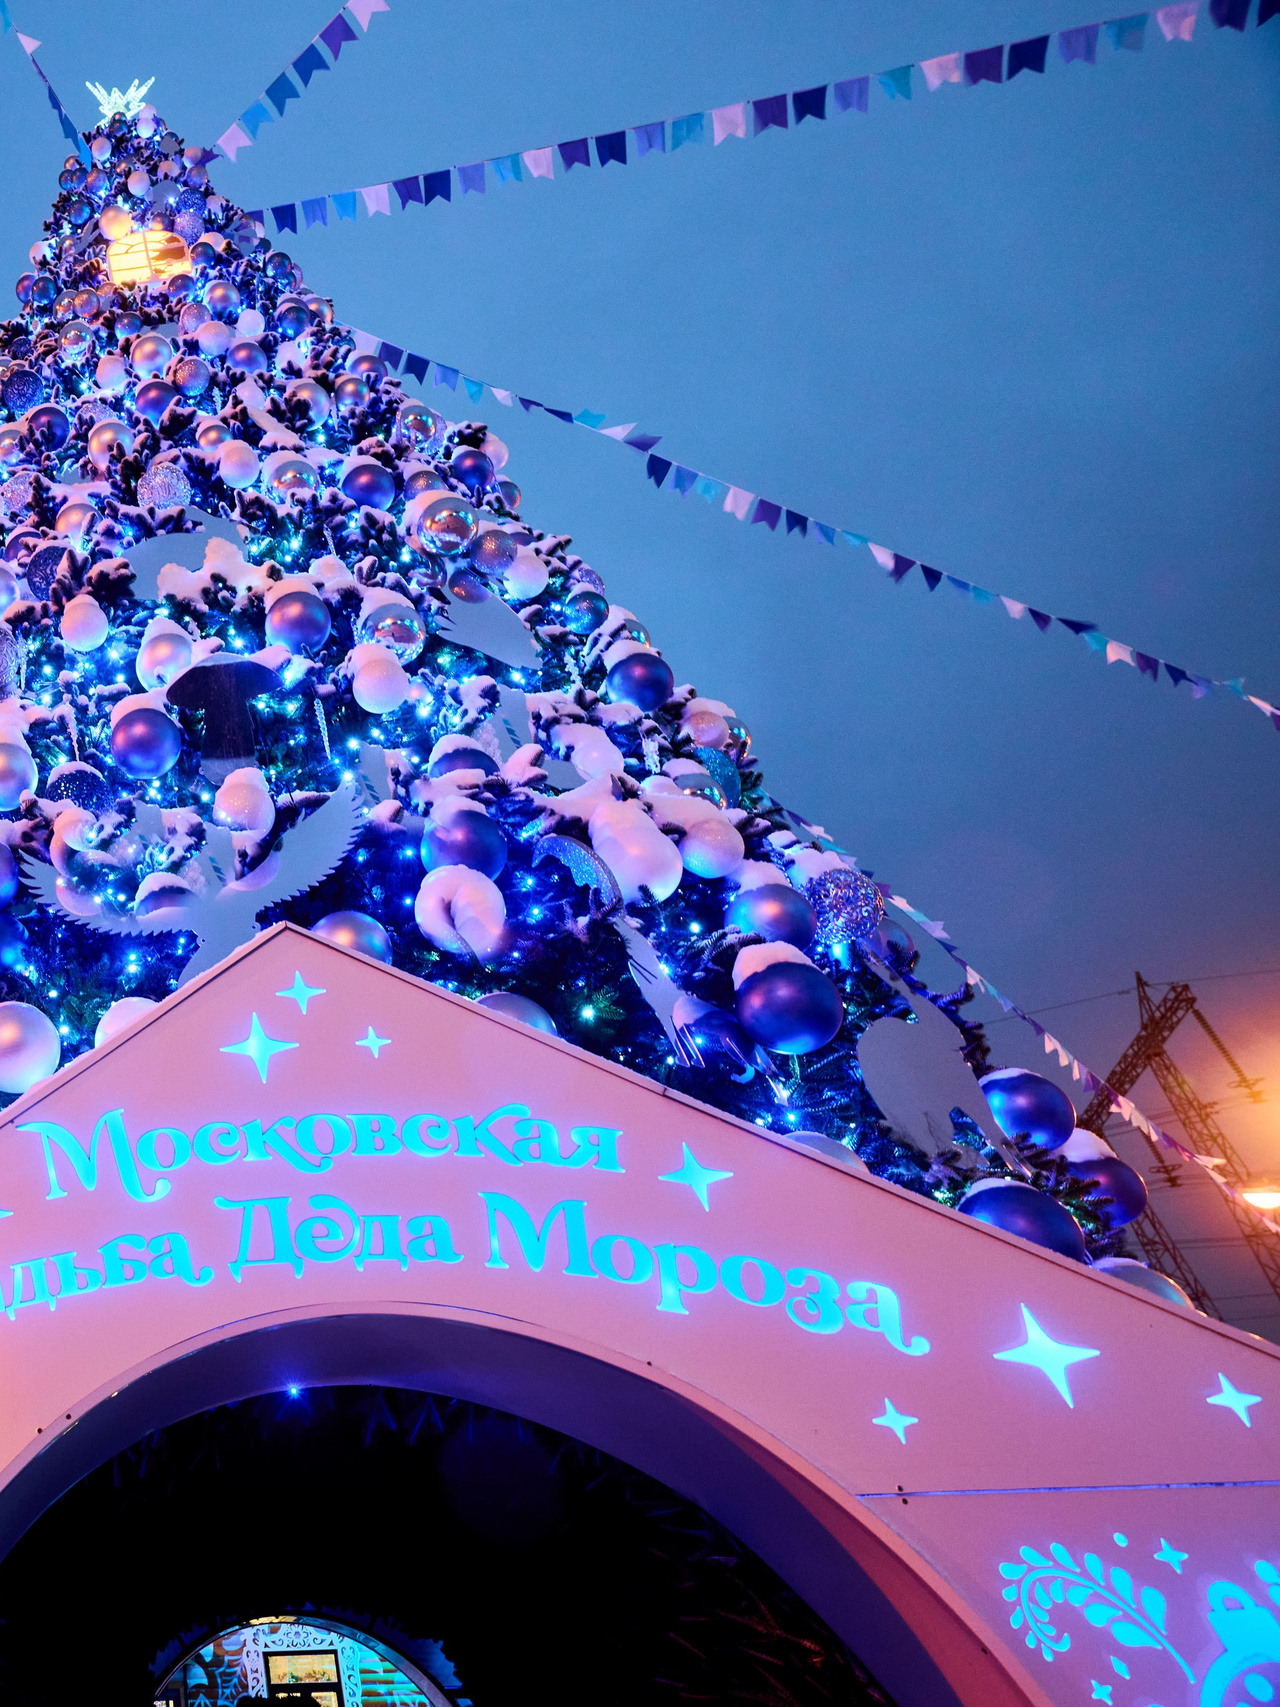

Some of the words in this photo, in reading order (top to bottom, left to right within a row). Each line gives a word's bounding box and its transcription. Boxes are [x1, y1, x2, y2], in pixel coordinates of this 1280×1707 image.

[16, 1103, 625, 1202] Московская
[214, 1194, 464, 1283] Деда
[478, 1192, 931, 1356] Мороза
